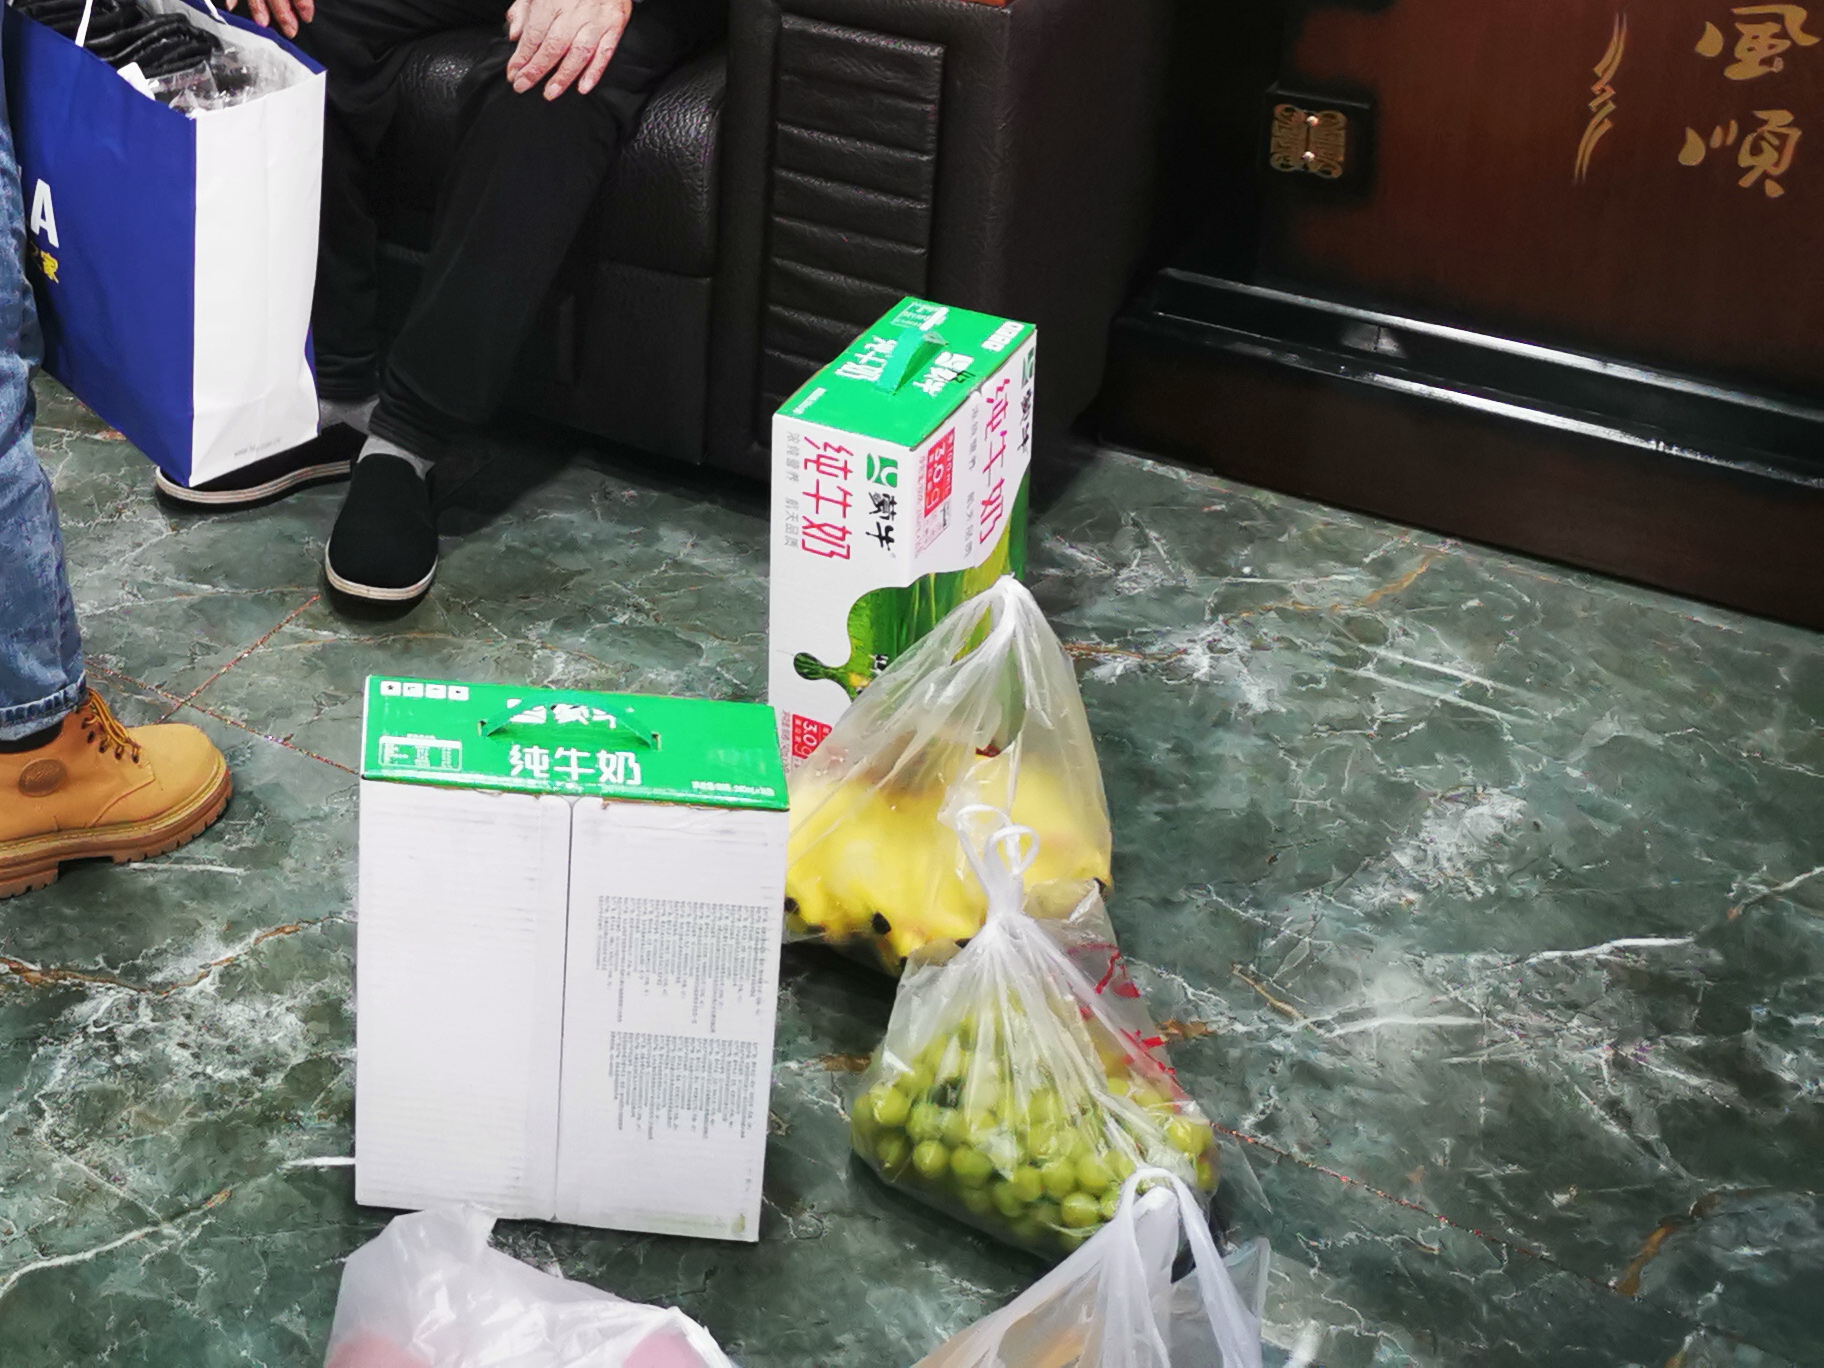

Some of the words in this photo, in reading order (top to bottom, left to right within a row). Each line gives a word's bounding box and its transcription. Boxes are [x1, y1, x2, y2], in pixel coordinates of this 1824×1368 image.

[801, 435, 855, 561] 纯牛奶
[978, 377, 1011, 546] 纯牛奶
[865, 491, 898, 552] 蒙牛
[508, 743, 643, 786] 纯牛奶
